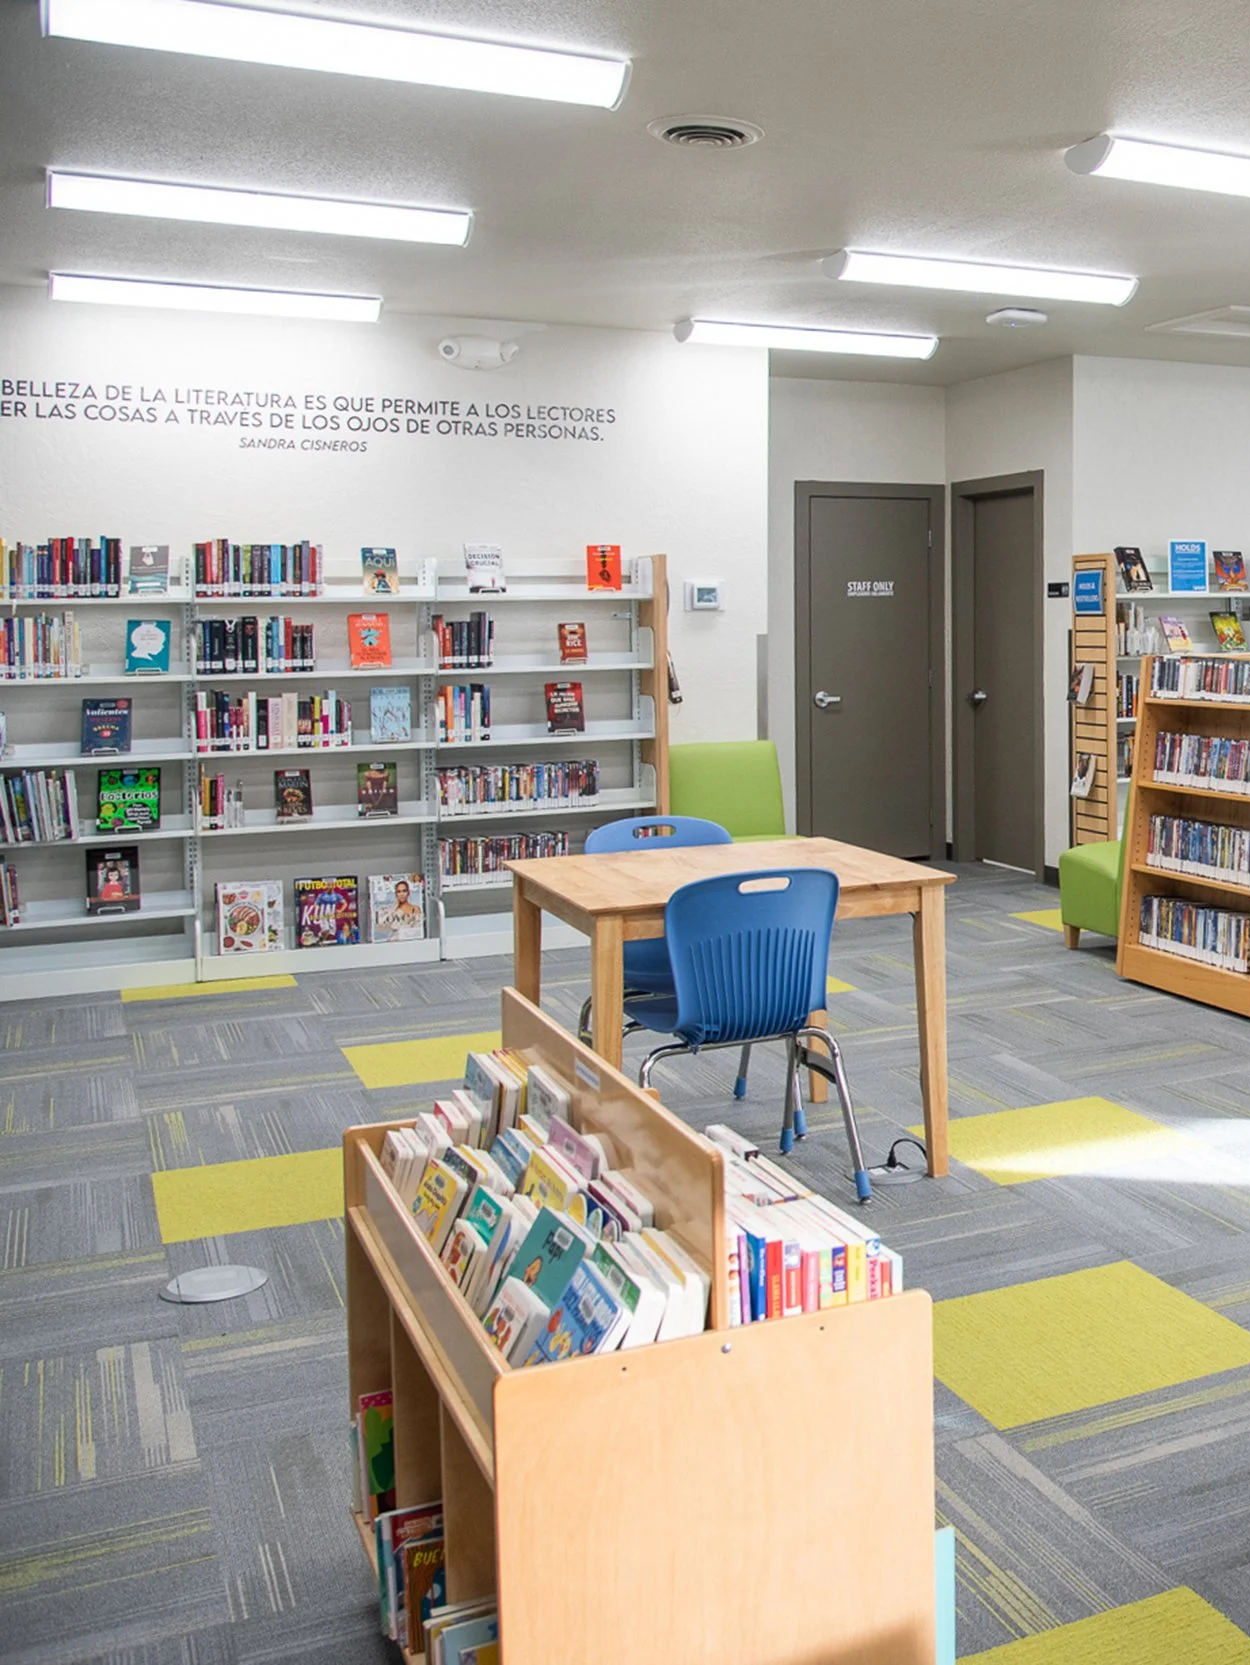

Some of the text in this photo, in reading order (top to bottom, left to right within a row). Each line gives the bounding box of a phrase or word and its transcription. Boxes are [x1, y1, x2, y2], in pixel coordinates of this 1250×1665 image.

[1, 379, 617, 424] BELLEZA DE LA LITERATURA ES QUE PERMITE A LOS LECTORES
[35, 402, 77, 420] LAS
[83, 404, 158, 424] COSAS
[165, 409, 180, 425] A
[187, 406, 264, 428] TRAVÉS
[269, 413, 296, 430] DE
[302, 414, 341, 431] LOS
[347, 415, 401, 434] OJOS
[406, 418, 431, 435] DE
[436, 419, 499, 437] OTRAS
[503, 422, 605, 442] PERSONAS.
[238, 437, 369, 453] SANDRA CISNEROS
[847, 580, 895, 592] STAFF ONLY
[299, 880, 335, 891] FUTBO
